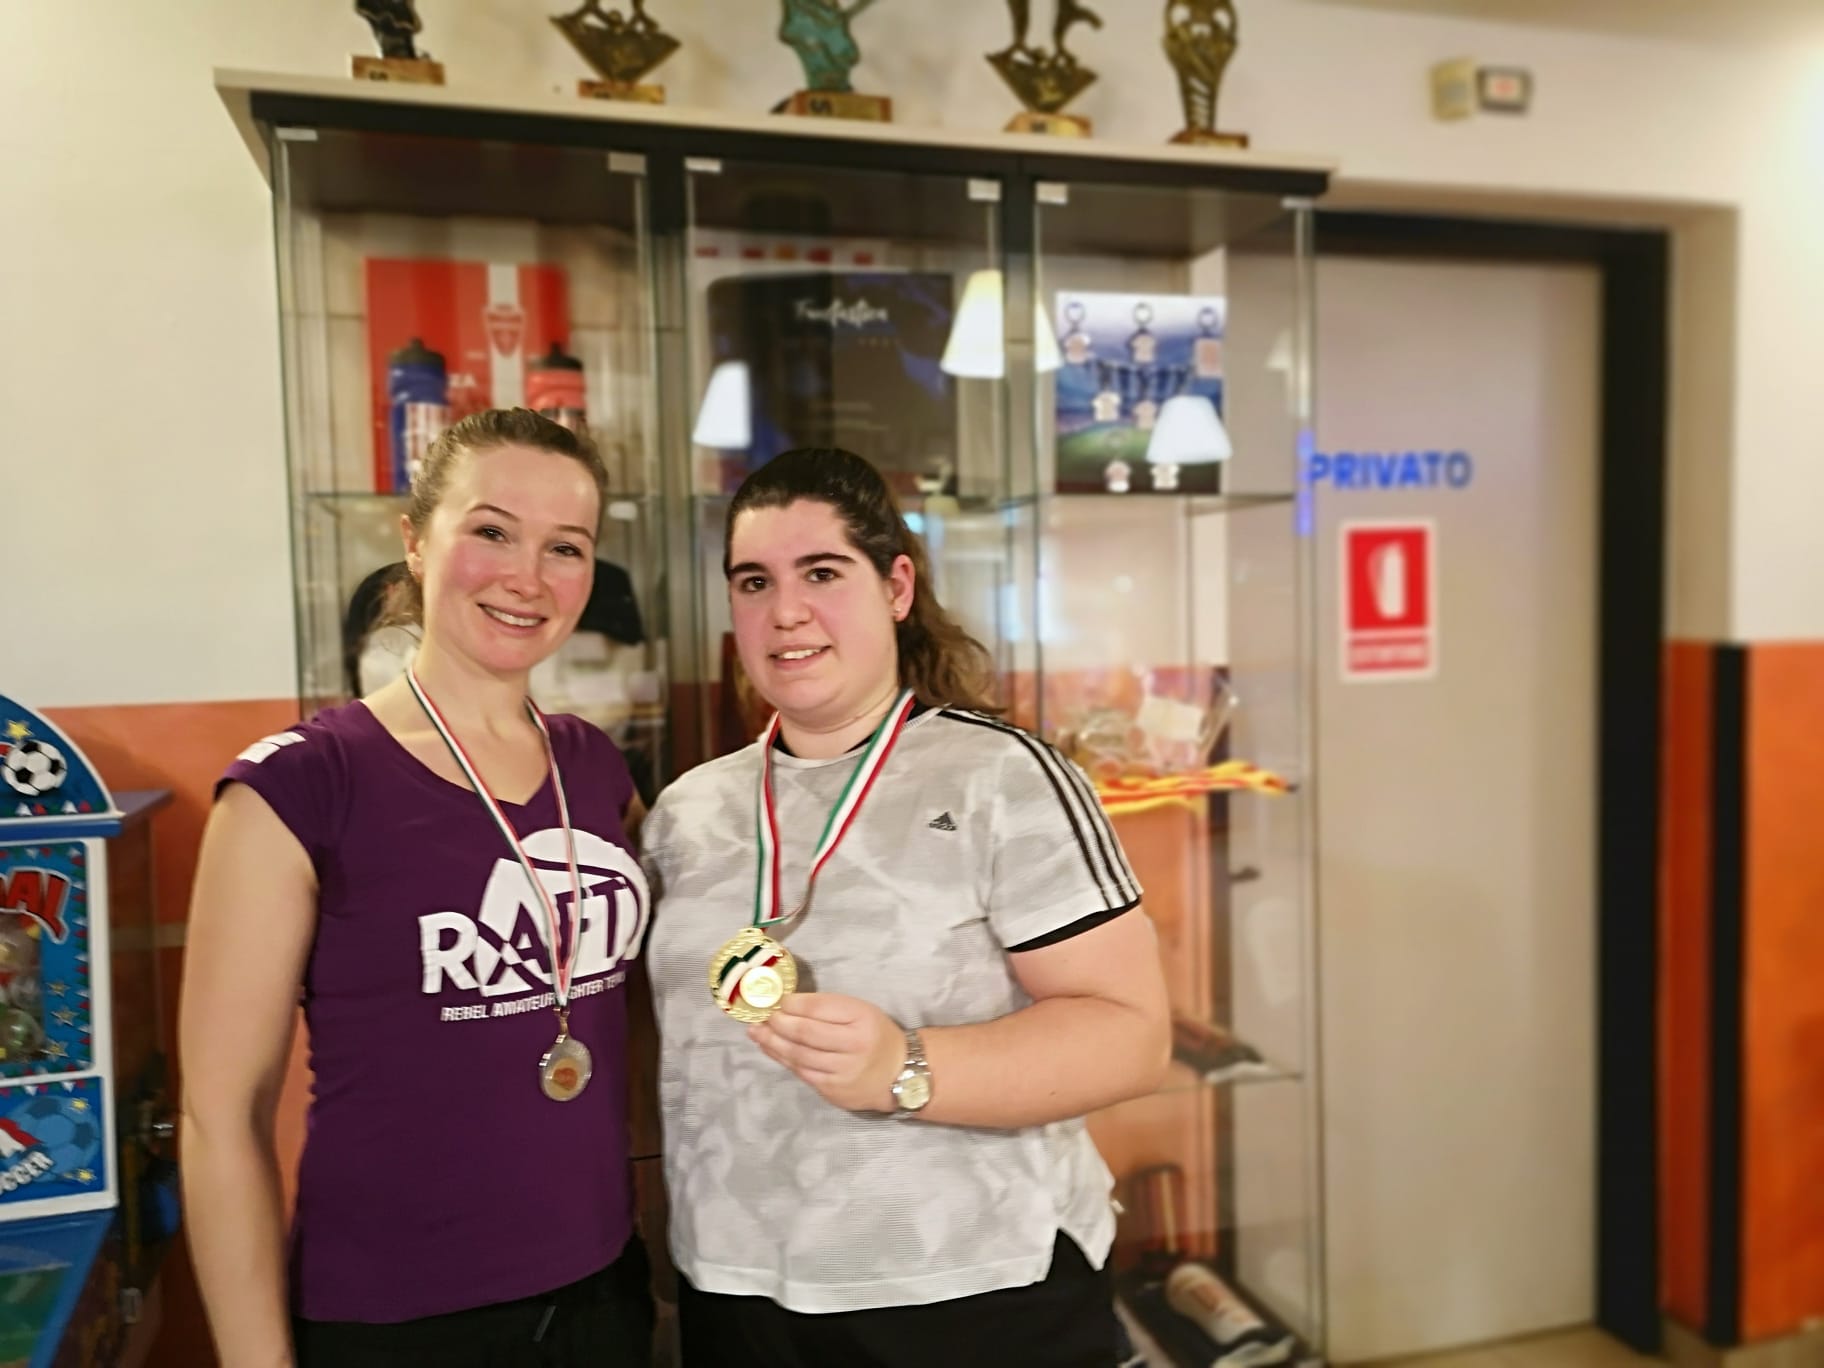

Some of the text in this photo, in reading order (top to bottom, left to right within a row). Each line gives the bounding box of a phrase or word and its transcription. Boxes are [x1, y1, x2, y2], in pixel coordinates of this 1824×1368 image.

[1308, 450, 1474, 491] PRIVATO
[440, 1005, 490, 1022] REBEL
[491, 992, 557, 1018] AMATEUR
[604, 971, 627, 990] TE
